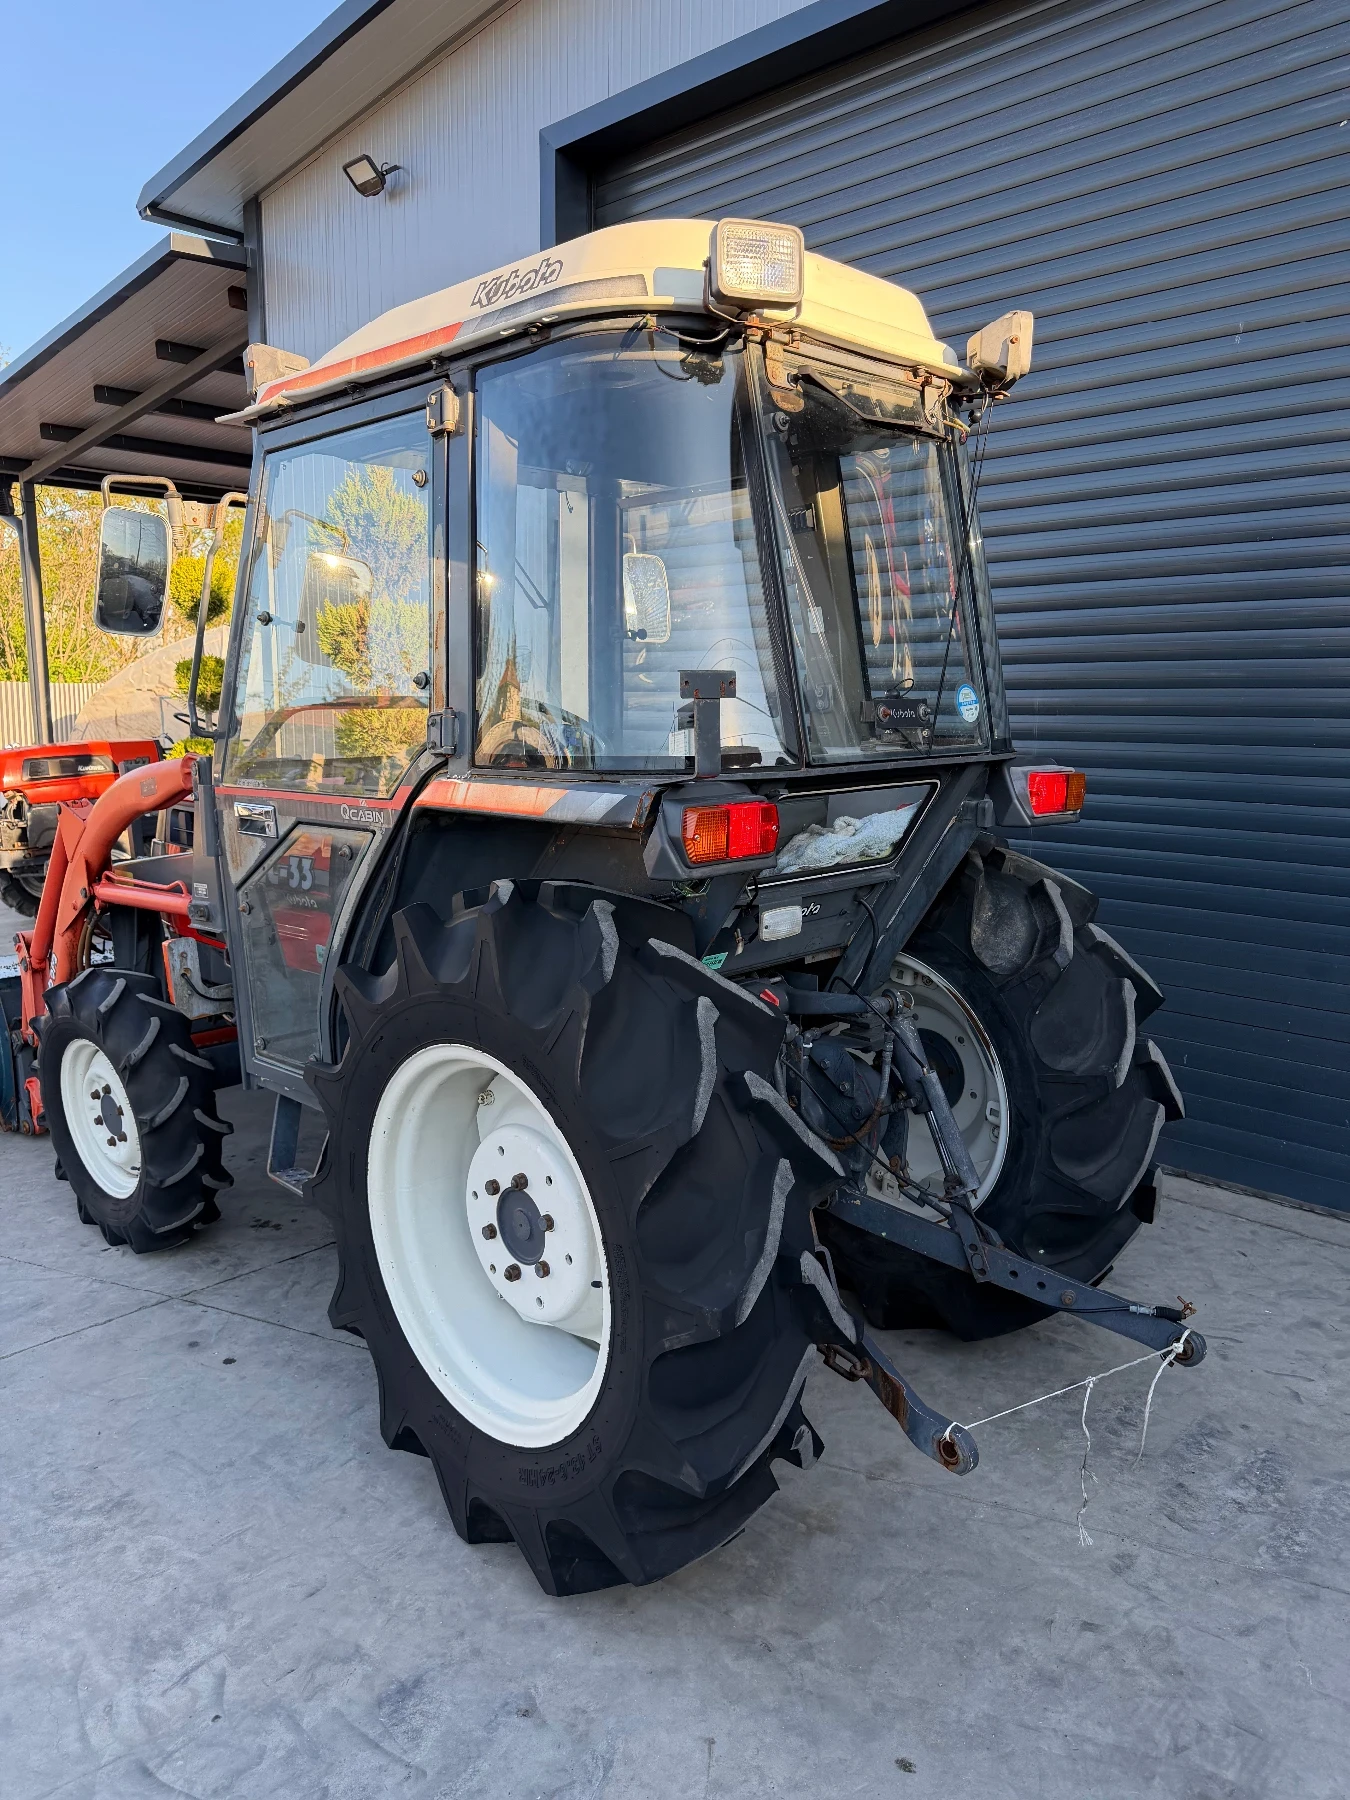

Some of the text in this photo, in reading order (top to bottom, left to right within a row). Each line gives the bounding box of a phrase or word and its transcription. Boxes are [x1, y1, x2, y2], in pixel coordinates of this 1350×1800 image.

[470, 257, 563, 308] Kubota
[890, 708, 916, 719] Kubota
[801, 902, 821, 916] ota
